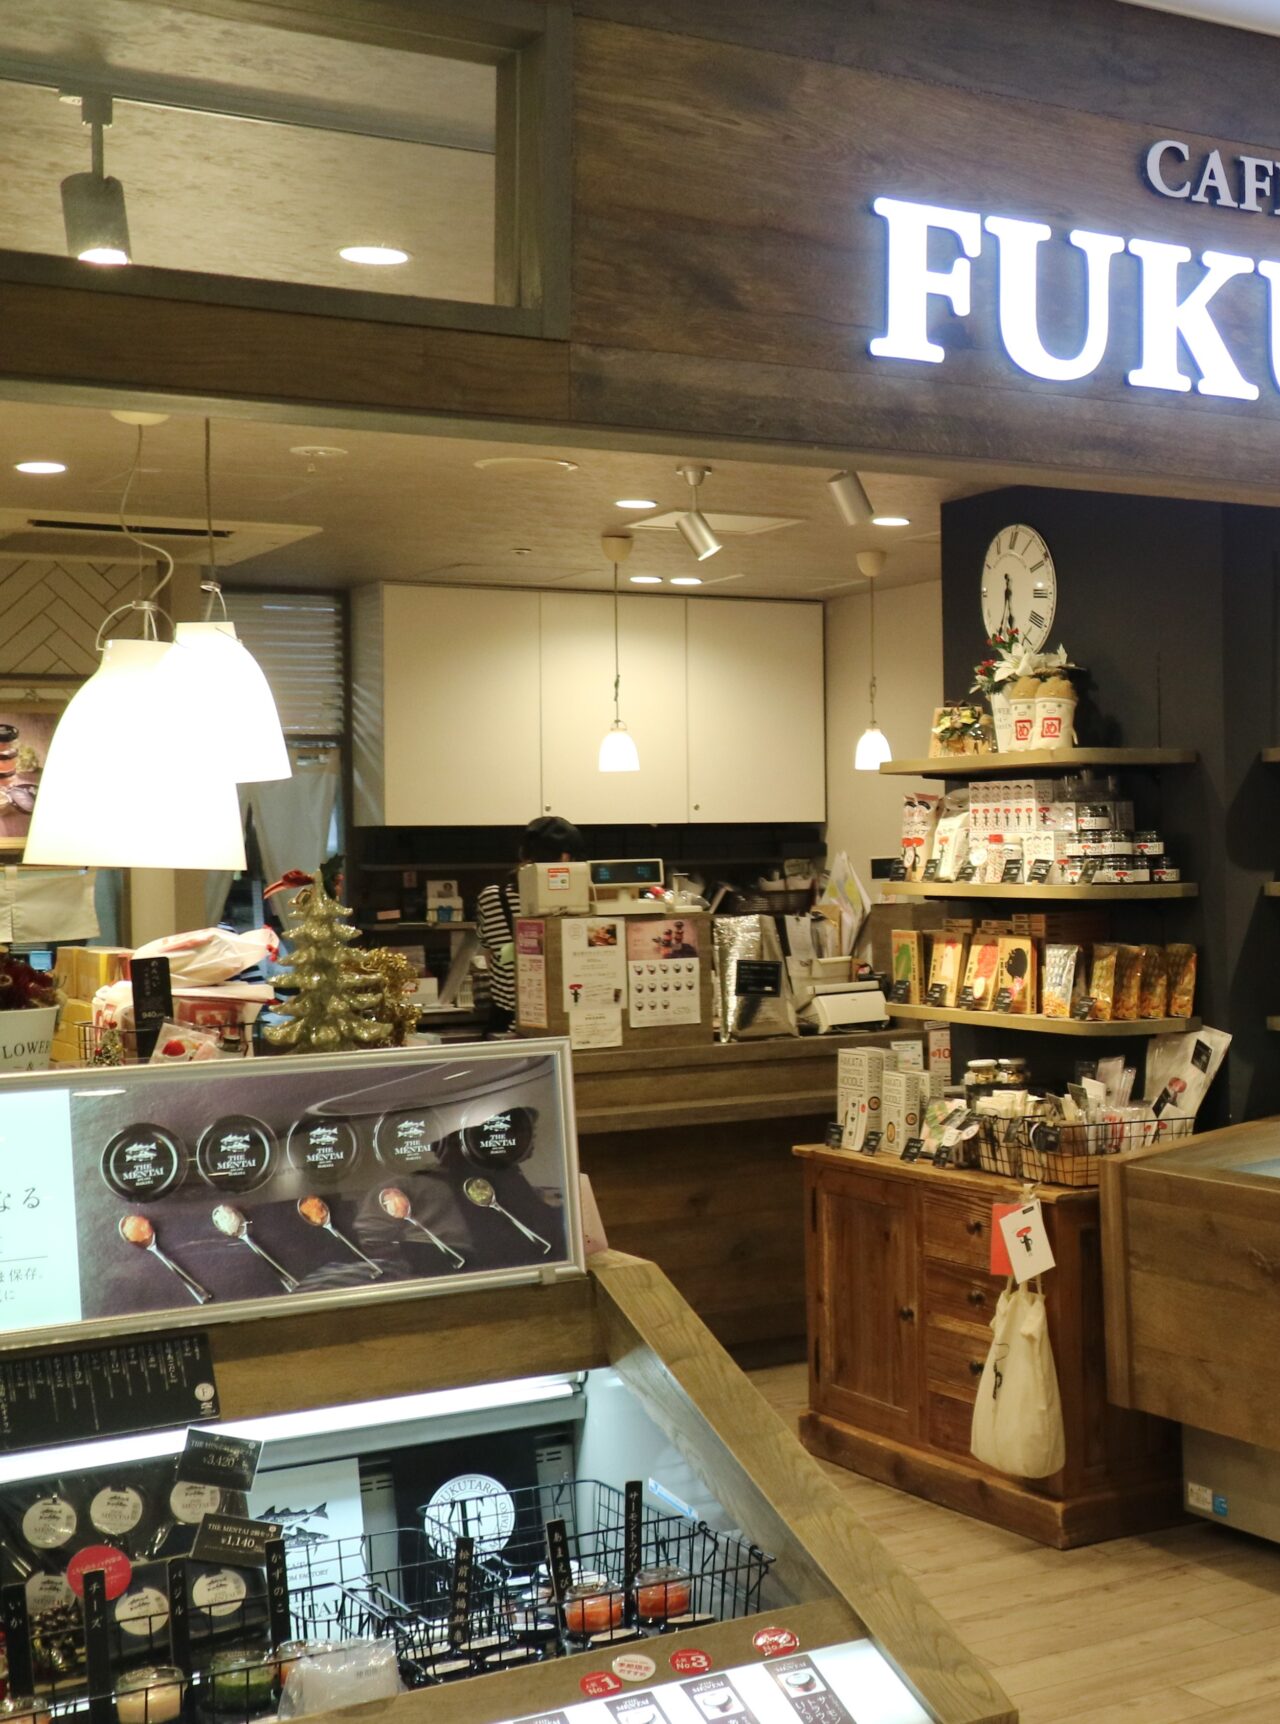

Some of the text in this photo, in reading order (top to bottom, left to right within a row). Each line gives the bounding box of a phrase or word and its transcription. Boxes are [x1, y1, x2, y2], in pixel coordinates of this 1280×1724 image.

[404, 1139, 420, 1148] THE
[479, 1138, 516, 1149] MENTAI
[489, 1133, 506, 1142] THE
[315, 1147, 334, 1155] THE
[394, 1143, 431, 1155] MENTAI
[227, 1153, 246, 1162] THE
[305, 1151, 344, 1163] MENTAI
[133, 1163, 152, 1173] THE
[217, 1158, 257, 1171] MENTAI
[122, 1168, 164, 1181] MENTAI
[629, 1490, 639, 1573] サーモントラウト
[271, 1552, 285, 1614] かずのこ
[690, 1655, 708, 1669] 3
[601, 1676, 620, 1691] 1
